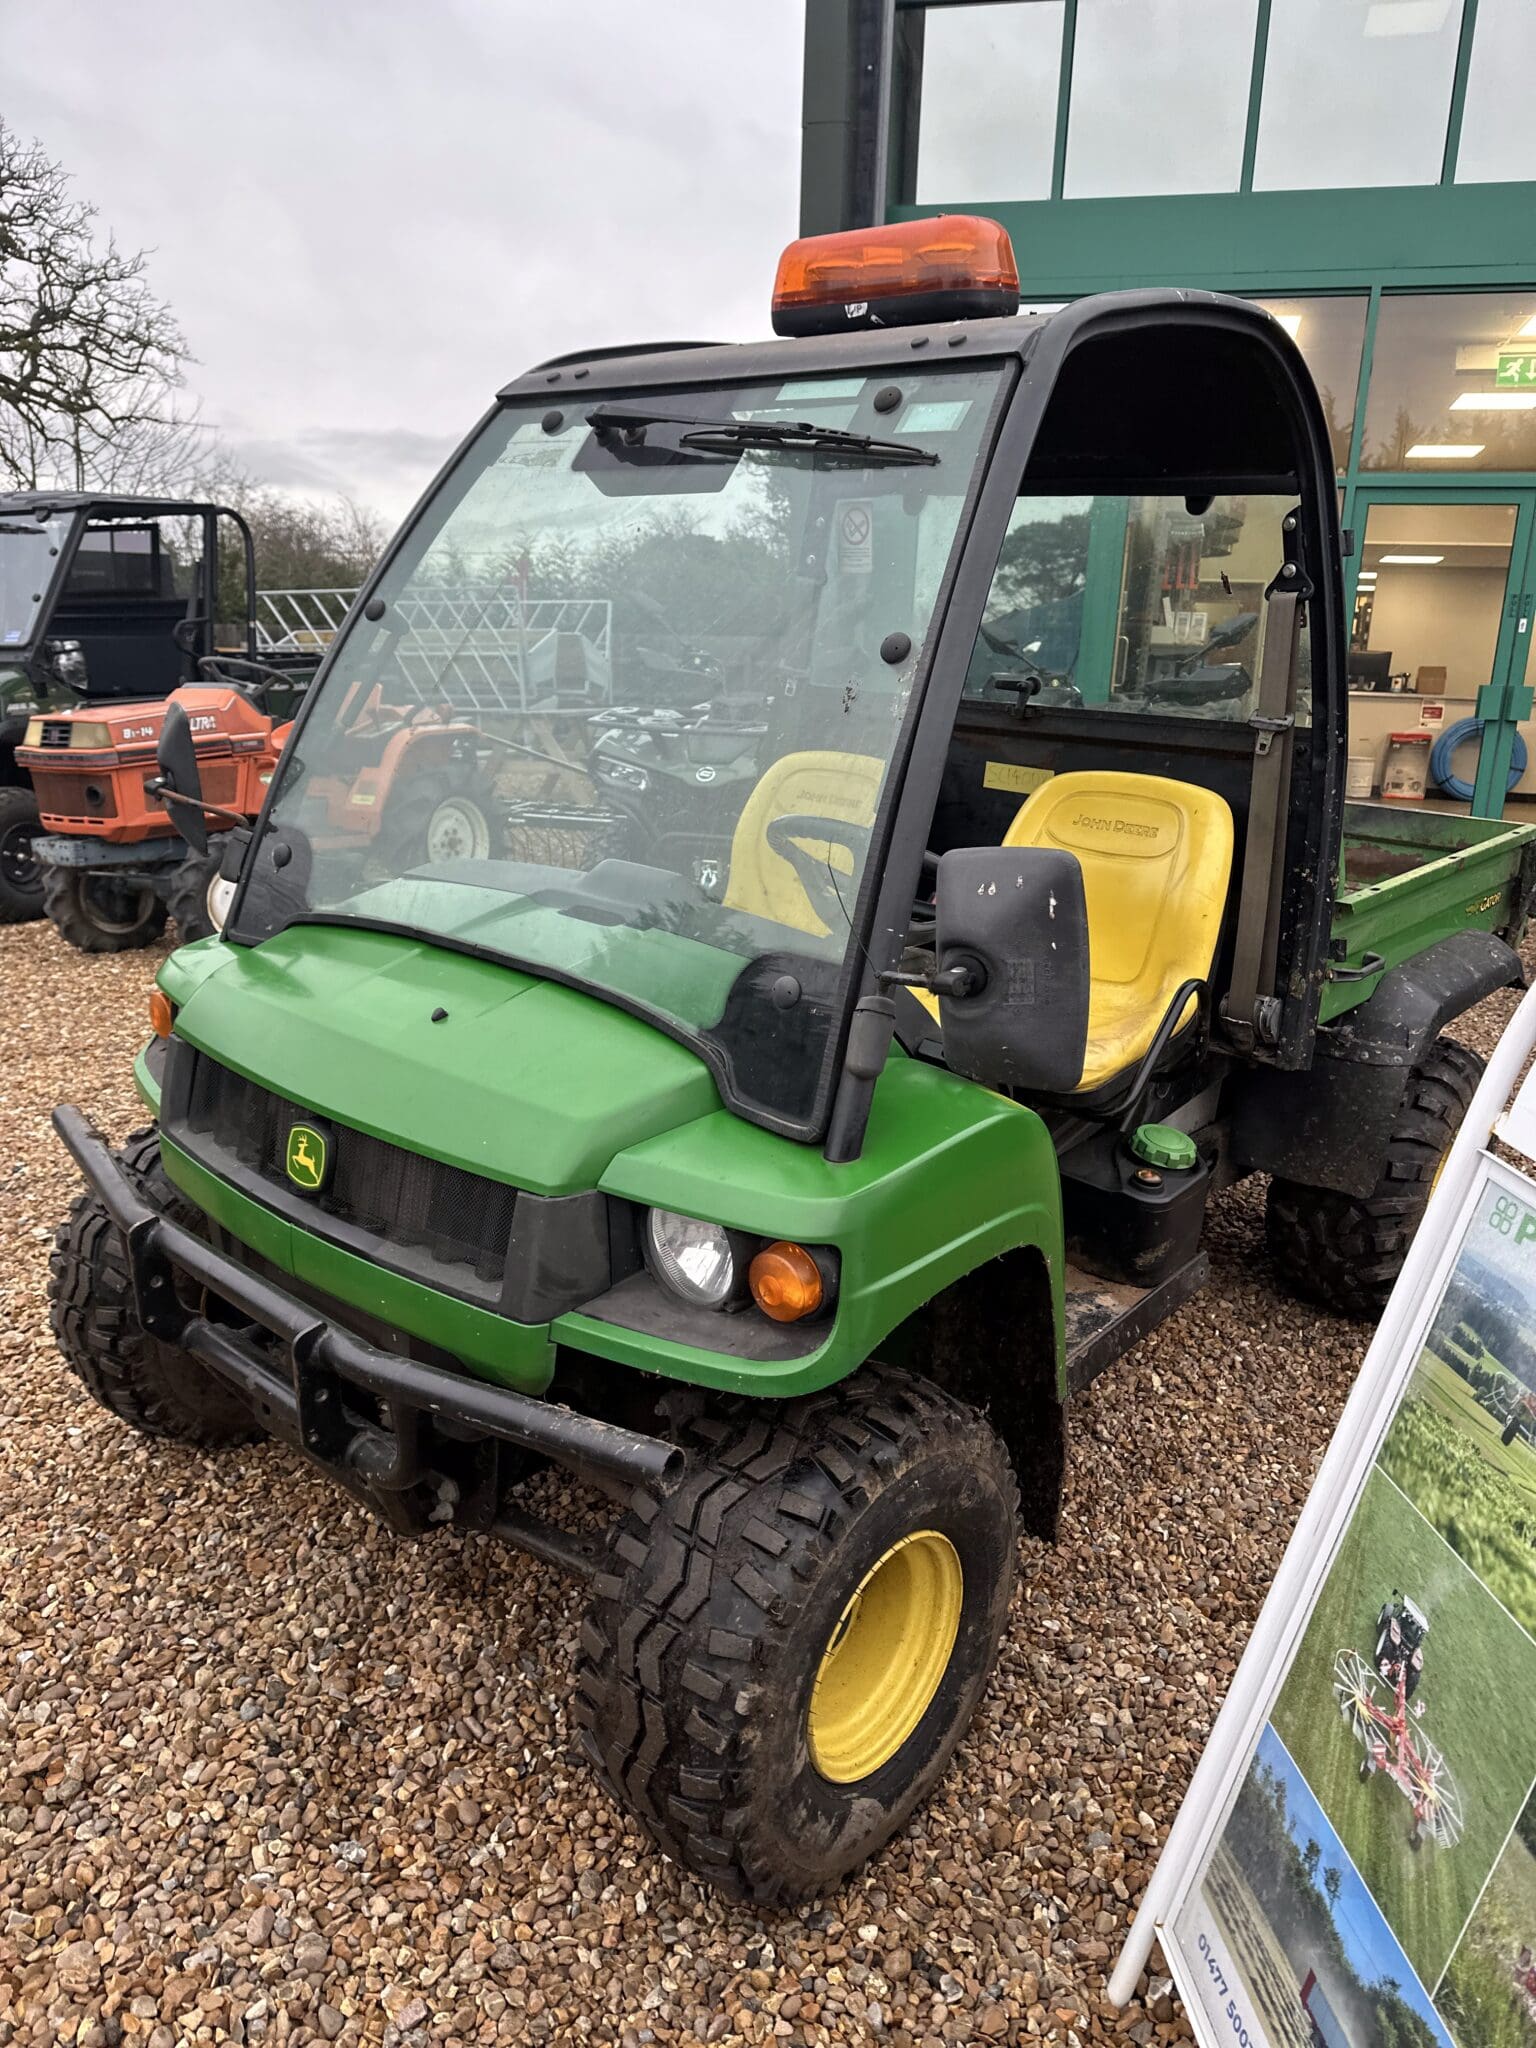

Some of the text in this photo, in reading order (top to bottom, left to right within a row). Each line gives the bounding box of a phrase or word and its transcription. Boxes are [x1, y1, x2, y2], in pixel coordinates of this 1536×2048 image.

[190, 715, 217, 731] LTRA
[1072, 813, 1160, 838] JOHN DEERE
[1198, 1933, 1256, 2048] 01477 500
